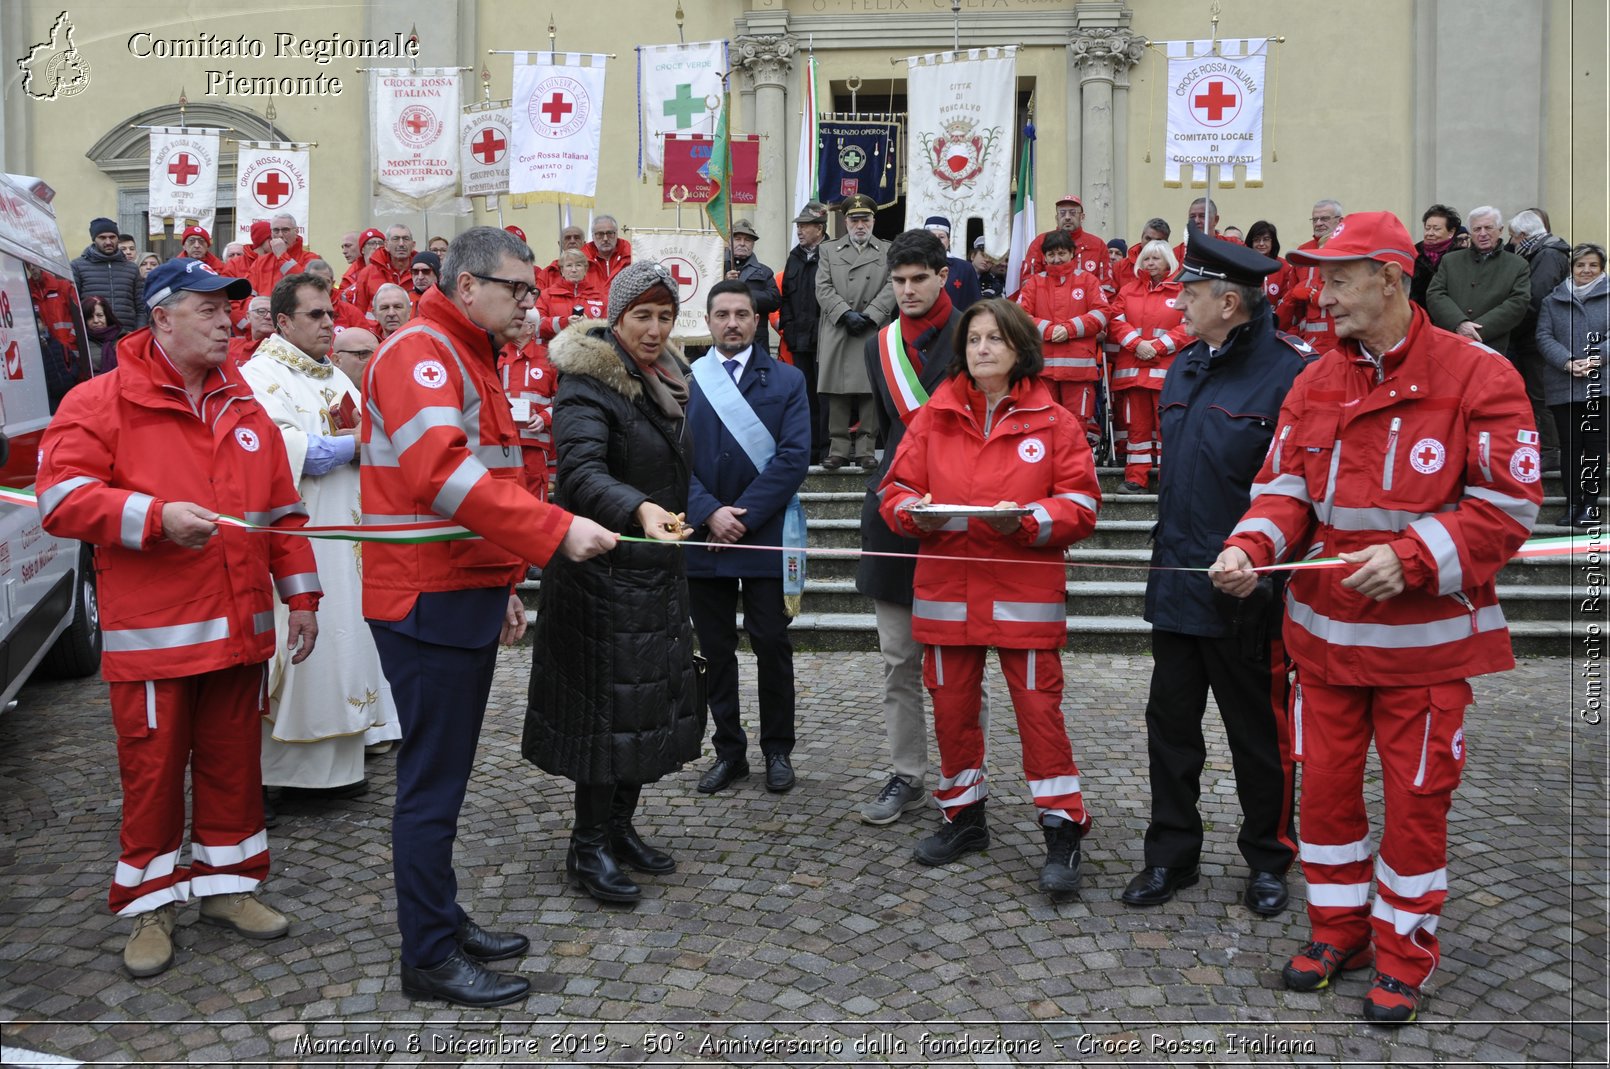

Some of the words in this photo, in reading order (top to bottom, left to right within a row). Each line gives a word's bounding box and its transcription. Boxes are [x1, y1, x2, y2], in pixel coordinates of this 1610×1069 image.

[655, 63, 683, 71] CROCE
[686, 60, 712, 69] VERDE
[383, 79, 416, 88] CROCE
[421, 78, 452, 87] ROSSA
[1175, 68, 1200, 97] CROCE
[1199, 62, 1227, 75] ROSSA
[1227, 64, 1257, 95] ITALIANA
[394, 89, 441, 98] ITALIANA
[939, 103, 981, 114] MONCALVO
[1174, 133, 1218, 142] COMITATO
[1221, 132, 1254, 141] LOCALE
[1210, 144, 1219, 152] DI
[562, 152, 589, 161] Italiana
[1173, 155, 1225, 163] COCCONATO
[1227, 155, 1254, 163] D'ASTI
[387, 159, 447, 167] MONTIGLIO
[529, 163, 562, 171] COMITATO
[241, 163, 257, 188] CROCE
[257, 156, 281, 168] ROSSA
[282, 159, 305, 190] ITALIANA
[382, 168, 453, 176] MONFERRATO
